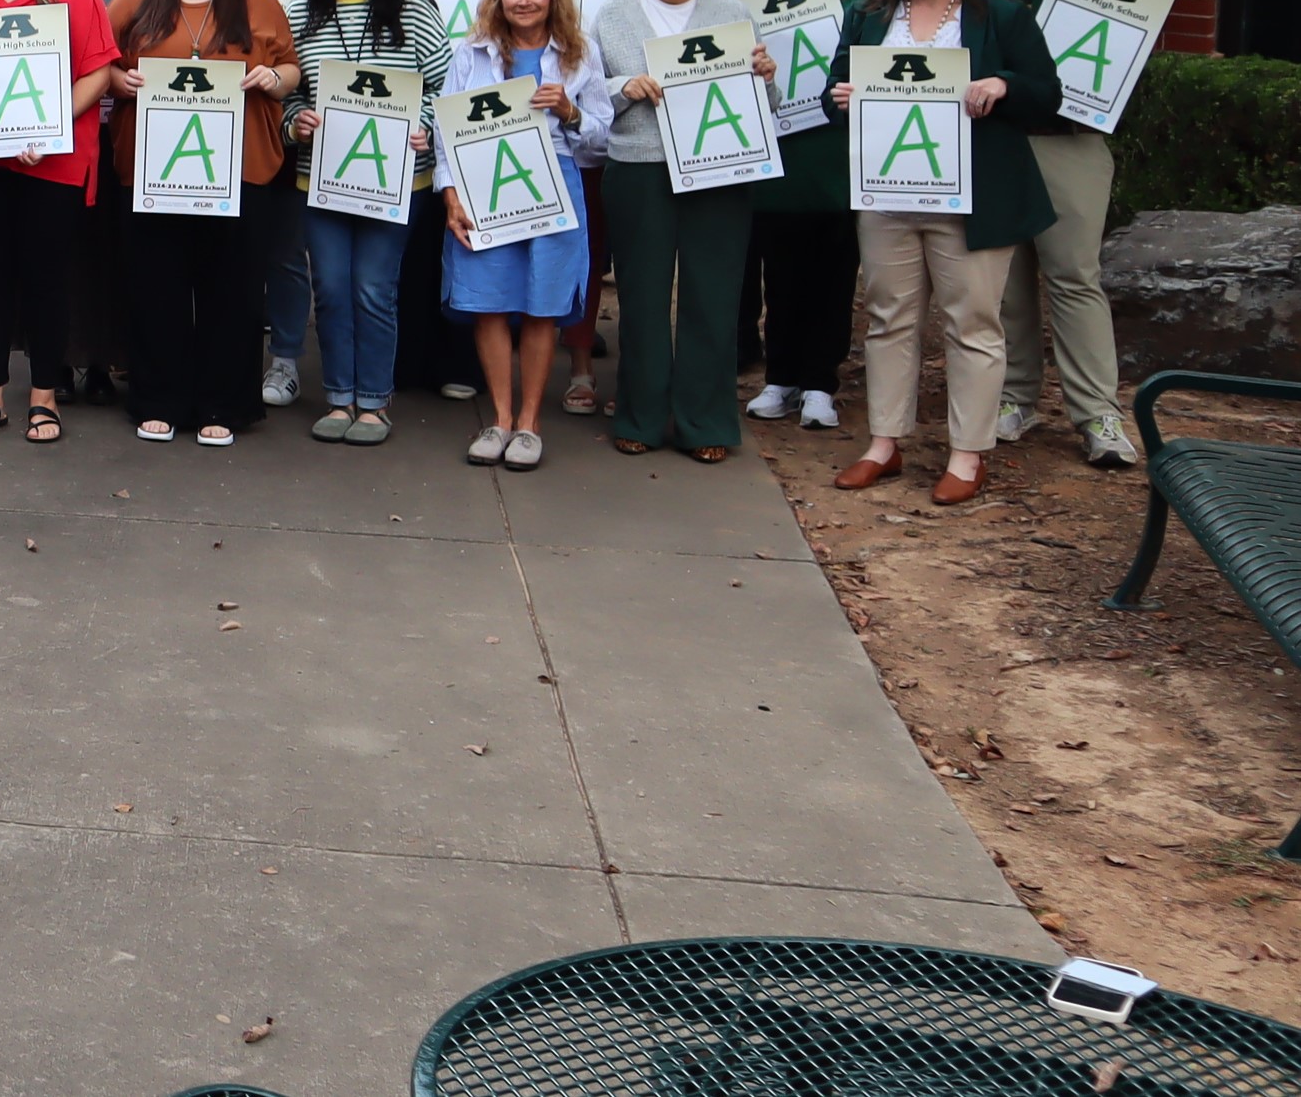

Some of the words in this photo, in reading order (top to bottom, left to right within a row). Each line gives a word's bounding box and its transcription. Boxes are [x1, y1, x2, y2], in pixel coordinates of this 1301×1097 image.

[775, 12, 795, 24] High
[797, 3, 827, 17] School
[1117, 5, 1149, 22] School
[3, 41, 23, 50] High
[26, 39, 54, 47] School
[677, 35, 725, 64] A
[1054, 19, 1112, 93] A
[664, 71, 687, 79] Alma
[689, 65, 711, 75] High
[713, 58, 744, 70] School
[787, 27, 831, 100] A
[883, 53, 935, 82] A
[168, 65, 214, 92] A
[347, 68, 391, 97] A
[894, 85, 917, 95] High
[151, 94, 174, 102] Alma
[177, 96, 197, 104] High
[200, 96, 230, 104] School
[330, 95, 352, 104] Alma
[354, 98, 374, 108] High
[377, 101, 406, 112] School
[466, 92, 511, 121] A
[455, 129, 477, 138] Alma
[478, 122, 500, 132] High
[501, 114, 531, 127] School
[692, 82, 750, 156] A
[160, 113, 215, 183] A
[334, 117, 388, 188] A
[879, 104, 942, 179] A
[489, 138, 543, 213] A
